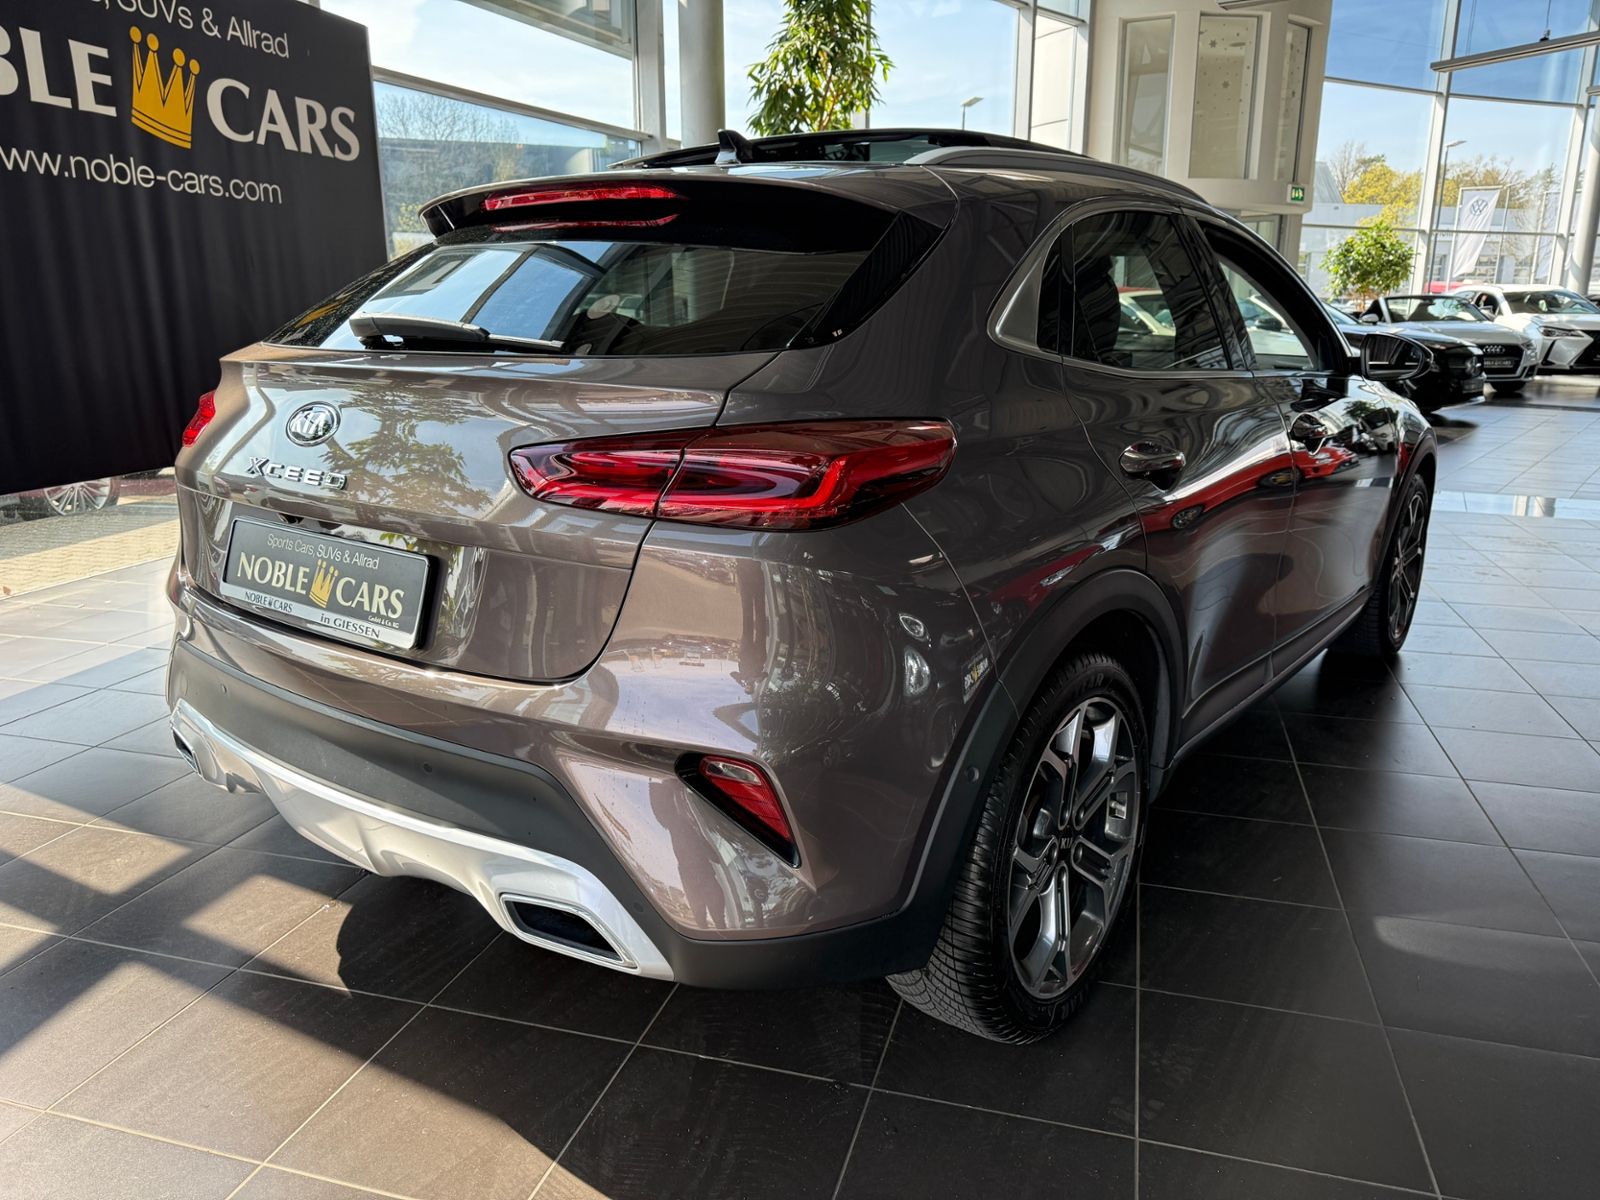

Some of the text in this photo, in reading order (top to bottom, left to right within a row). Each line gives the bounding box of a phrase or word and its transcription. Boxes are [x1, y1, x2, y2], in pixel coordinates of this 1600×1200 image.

[201, 8, 222, 39] &
[227, 16, 290, 58] Allrad
[206, 77, 361, 162] CARS
[267, 533, 380, 570] Sports Cars, SUVs & Allrad
[237, 551, 405, 619] NOBLE CARS
[244, 591, 293, 613] NOBLE CARS
[320, 613, 380, 639] in GIESSEN
